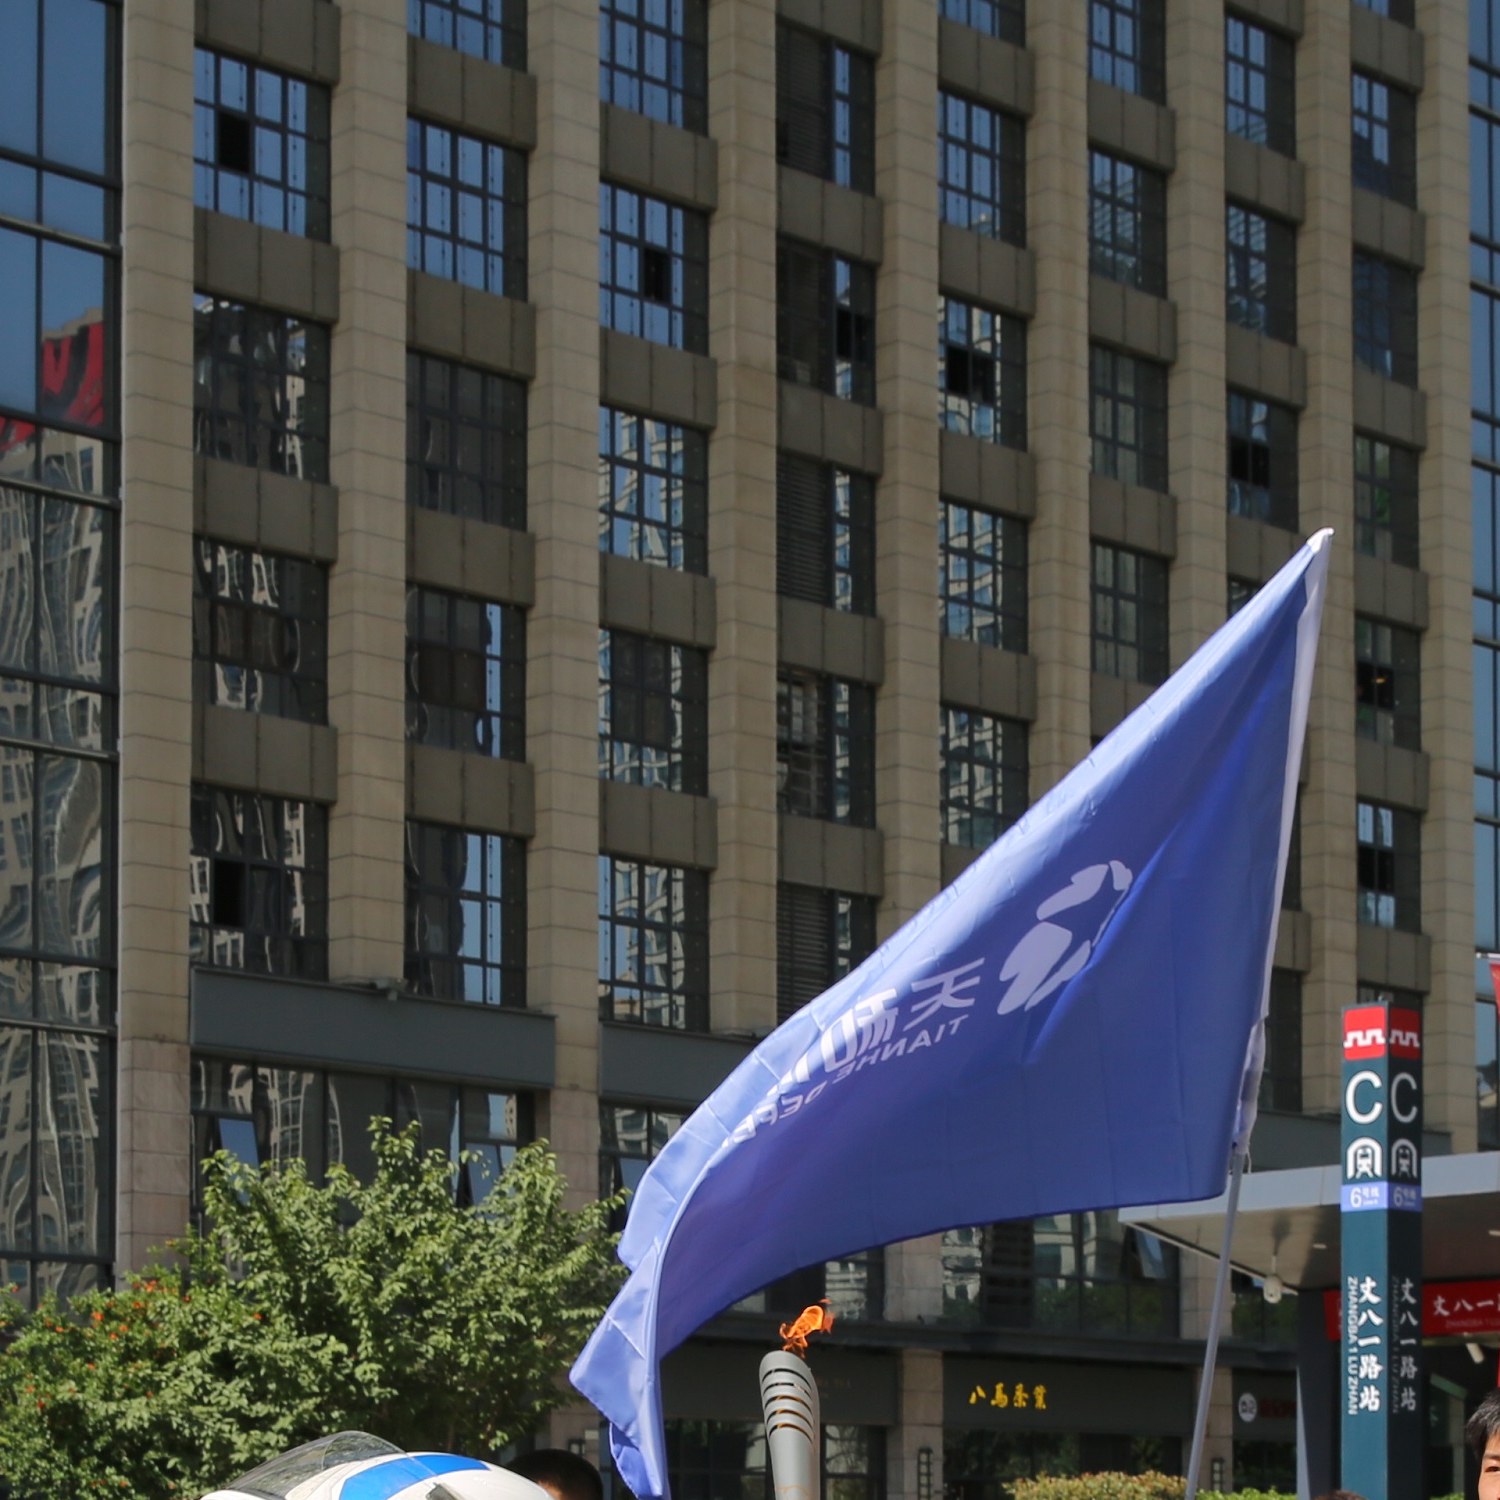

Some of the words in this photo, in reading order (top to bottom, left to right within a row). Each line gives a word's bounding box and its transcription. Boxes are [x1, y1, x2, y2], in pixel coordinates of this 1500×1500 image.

[1345, 1070, 1383, 1124] C
[1390, 1072, 1418, 1123] C
[1347, 1276, 1359, 1344] ZHANGBA
[1347, 1356, 1358, 1374] LU
[1358, 1275, 1384, 1412] 丈八一路站
[1400, 1277, 1419, 1411] 丈八一路站
[1347, 1376, 1359, 1415] ZHAN
